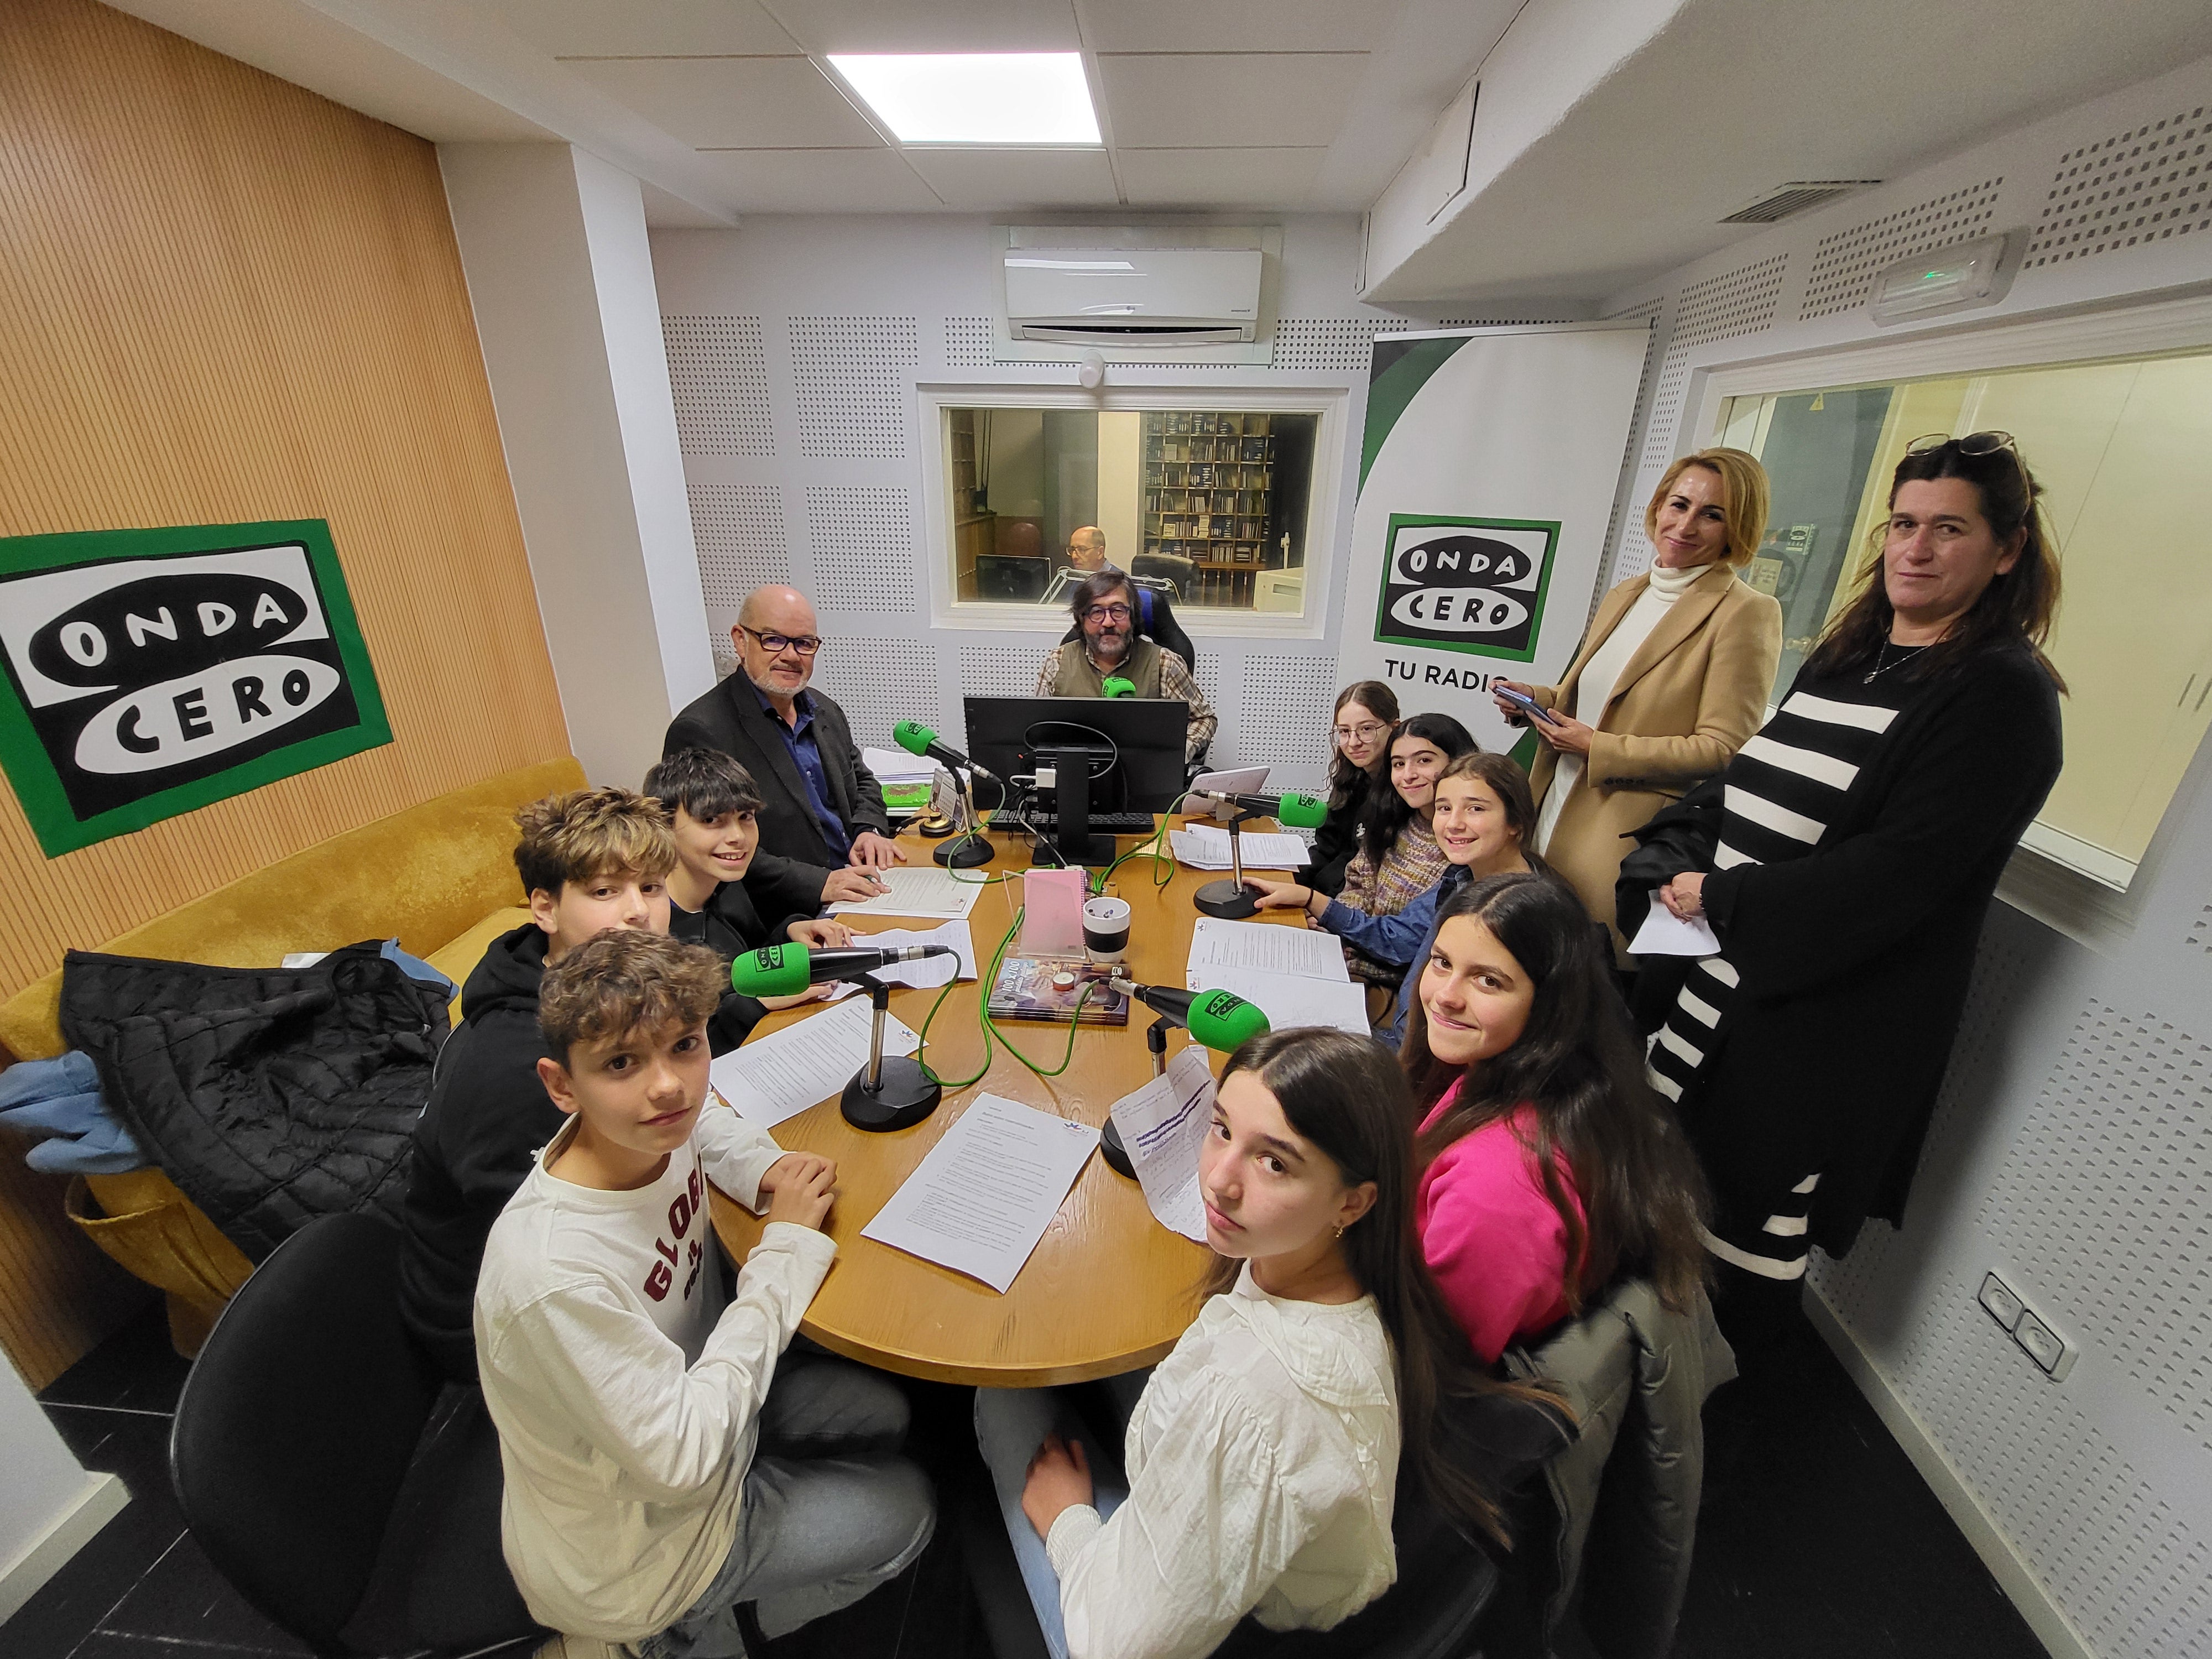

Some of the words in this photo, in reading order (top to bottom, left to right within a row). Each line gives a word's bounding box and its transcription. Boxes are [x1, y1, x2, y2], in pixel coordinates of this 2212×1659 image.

[1409, 549, 1516, 577] ONDA
[59, 593, 288, 667] ONDA
[1409, 596, 1510, 625] CERO
[1385, 659, 1416, 680] TU
[116, 669, 311, 754] CERO
[644, 1151, 703, 1302] GLOB
